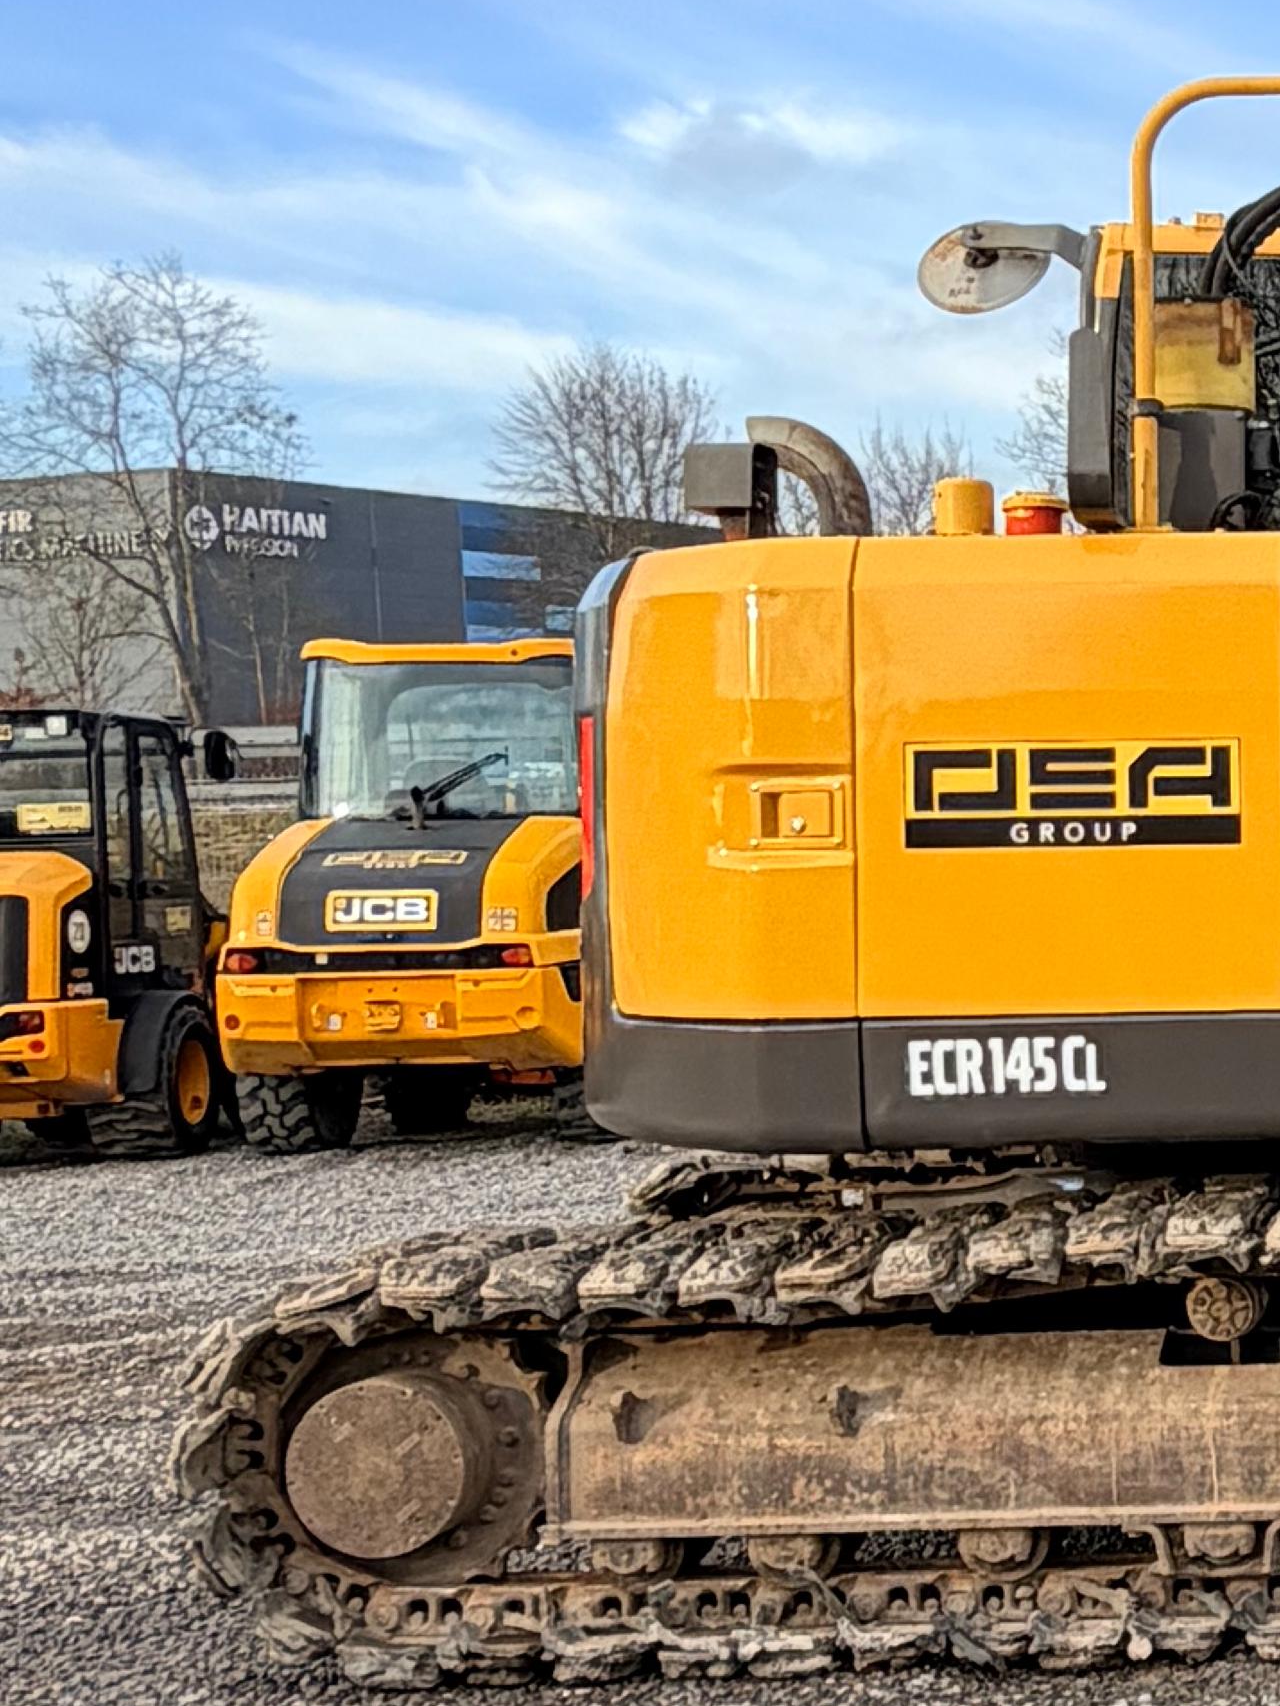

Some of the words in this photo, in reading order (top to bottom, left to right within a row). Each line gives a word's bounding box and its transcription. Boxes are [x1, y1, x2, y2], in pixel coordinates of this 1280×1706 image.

[222, 503, 328, 539] HAITIAN
[1009, 821, 1137, 843] GROUP
[334, 896, 428, 922] JCB
[113, 945, 155, 974] JCB
